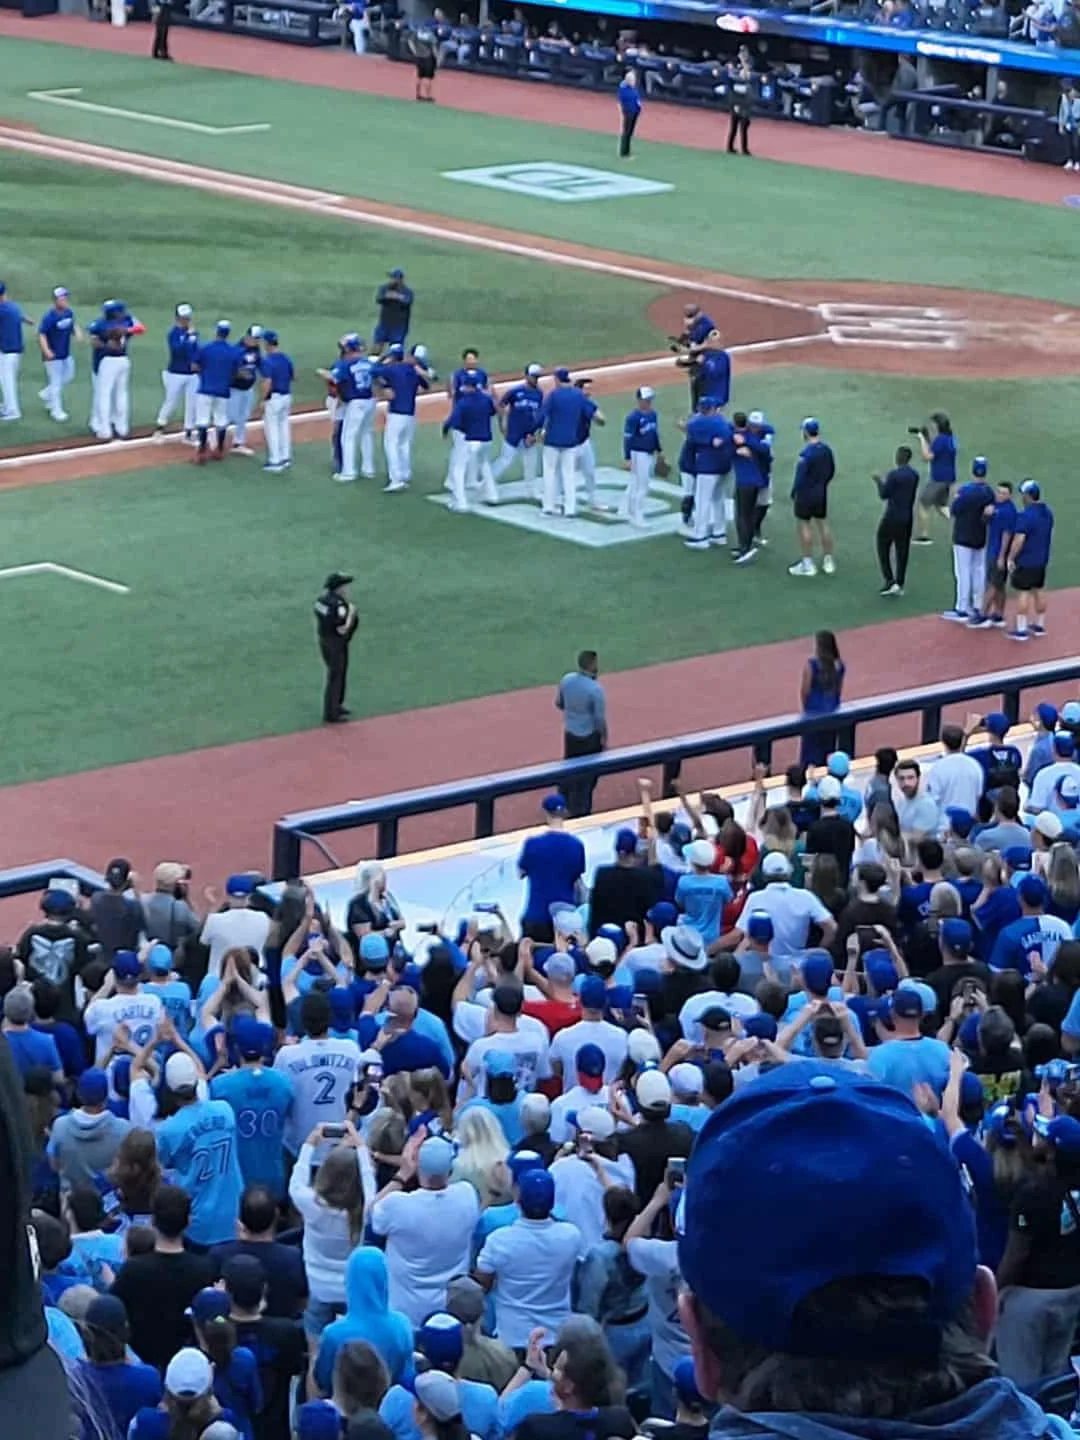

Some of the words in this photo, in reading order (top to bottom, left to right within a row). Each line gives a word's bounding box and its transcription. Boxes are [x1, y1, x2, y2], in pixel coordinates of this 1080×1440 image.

[313, 1071, 336, 1105] 2
[239, 1108, 279, 1139] 30
[191, 1136, 233, 1182] 27
